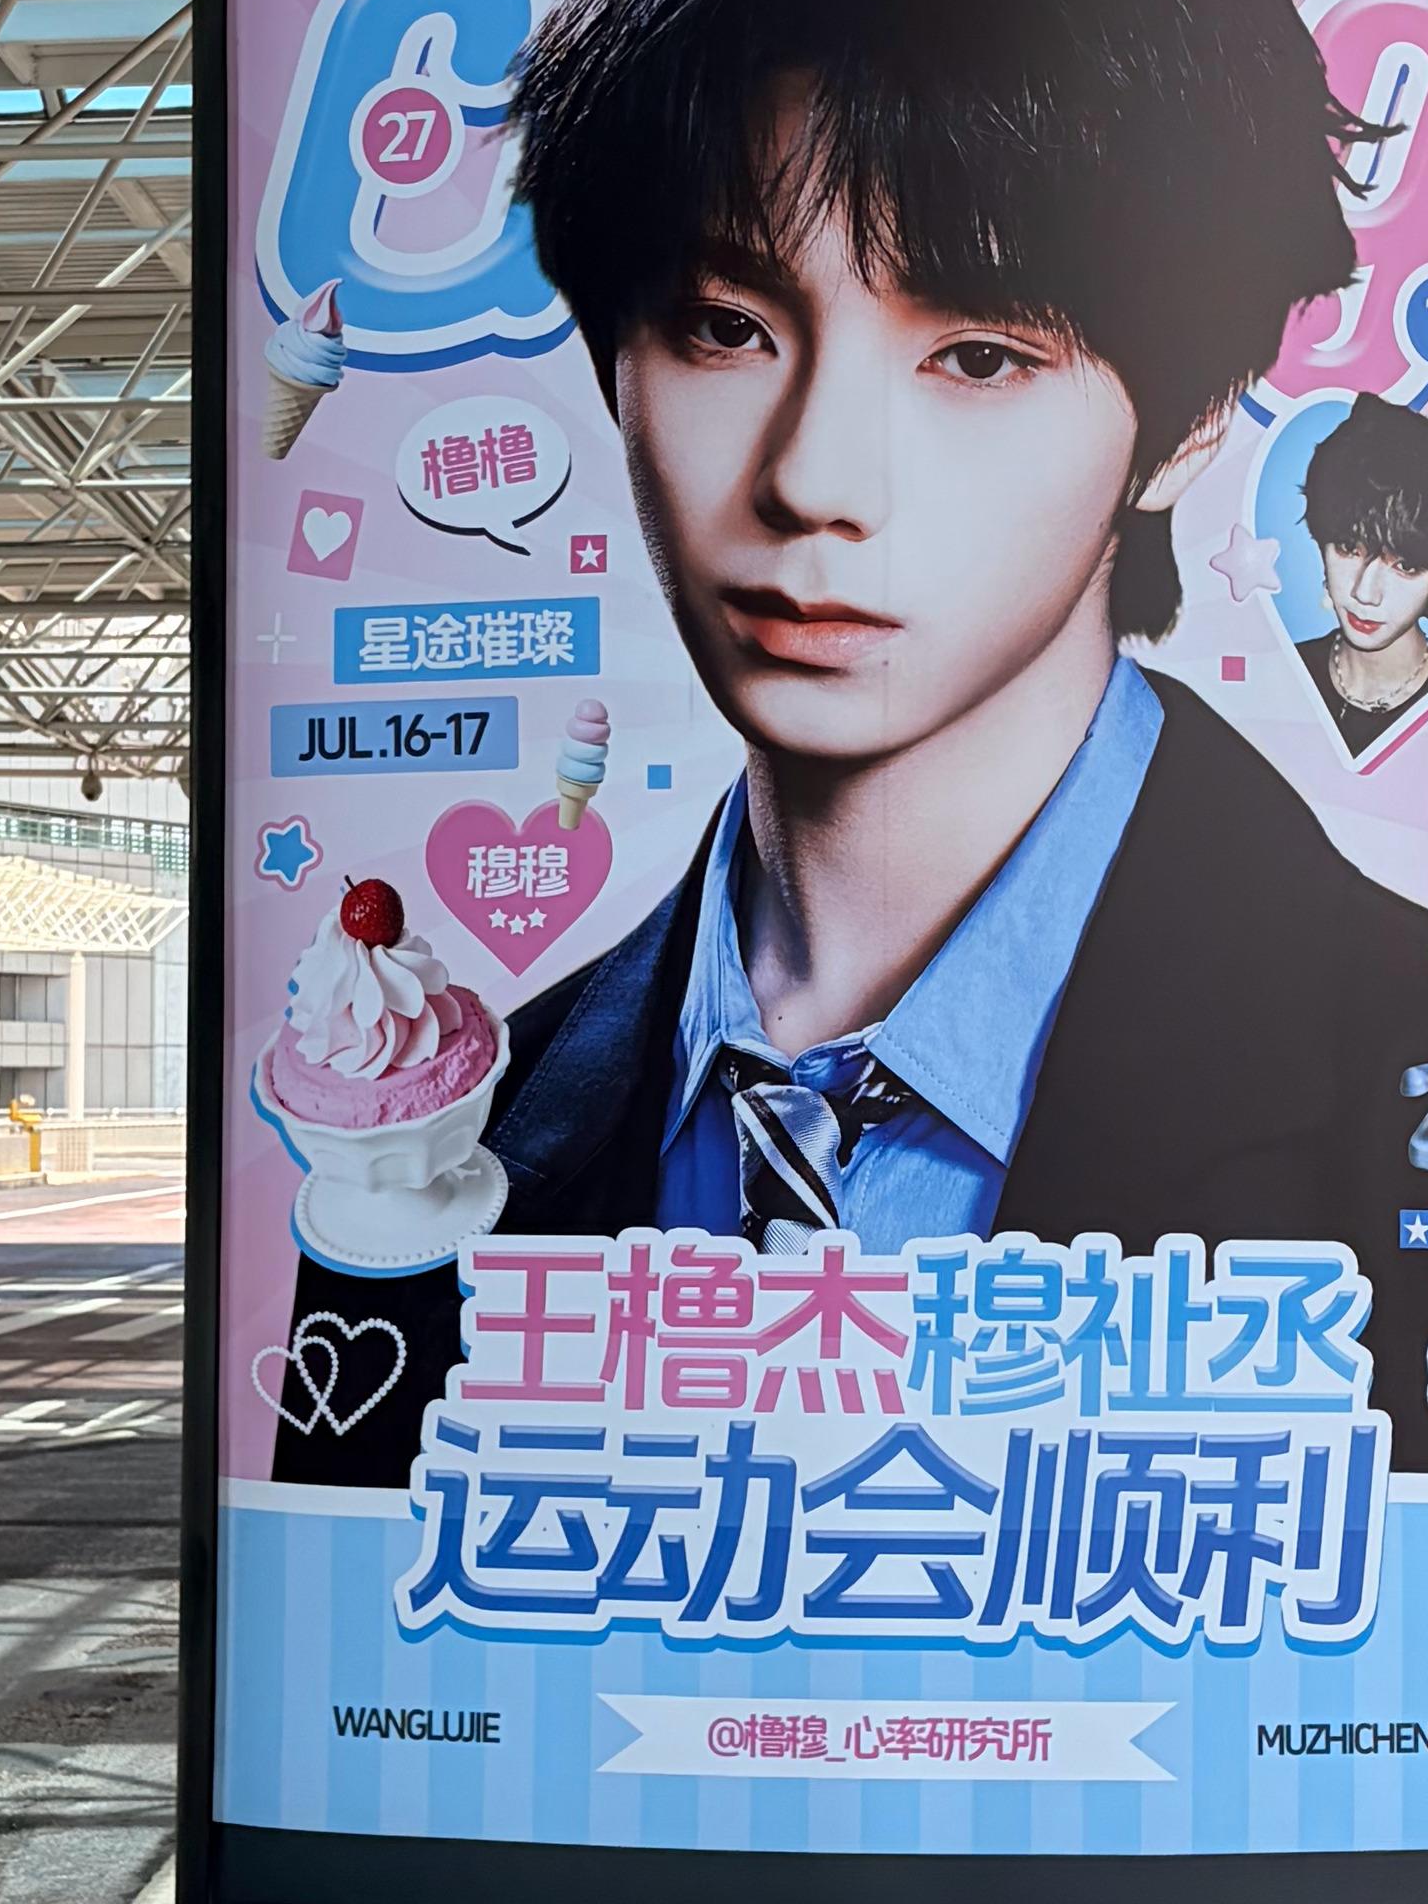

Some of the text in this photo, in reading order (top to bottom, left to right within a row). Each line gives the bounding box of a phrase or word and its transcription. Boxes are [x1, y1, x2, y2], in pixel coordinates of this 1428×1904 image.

[377, 109, 437, 164] 27
[419, 423, 539, 500] 橹橹
[358, 609, 576, 674] 星途璀璨
[298, 711, 491, 762] JUL.16-17
[465, 843, 571, 899] 穆穆
[460, 1243, 1361, 1417] 王橹杰穆祉丞
[409, 1416, 1379, 1627] 运动会顺利
[332, 1704, 502, 1745] WANGLUJIE
